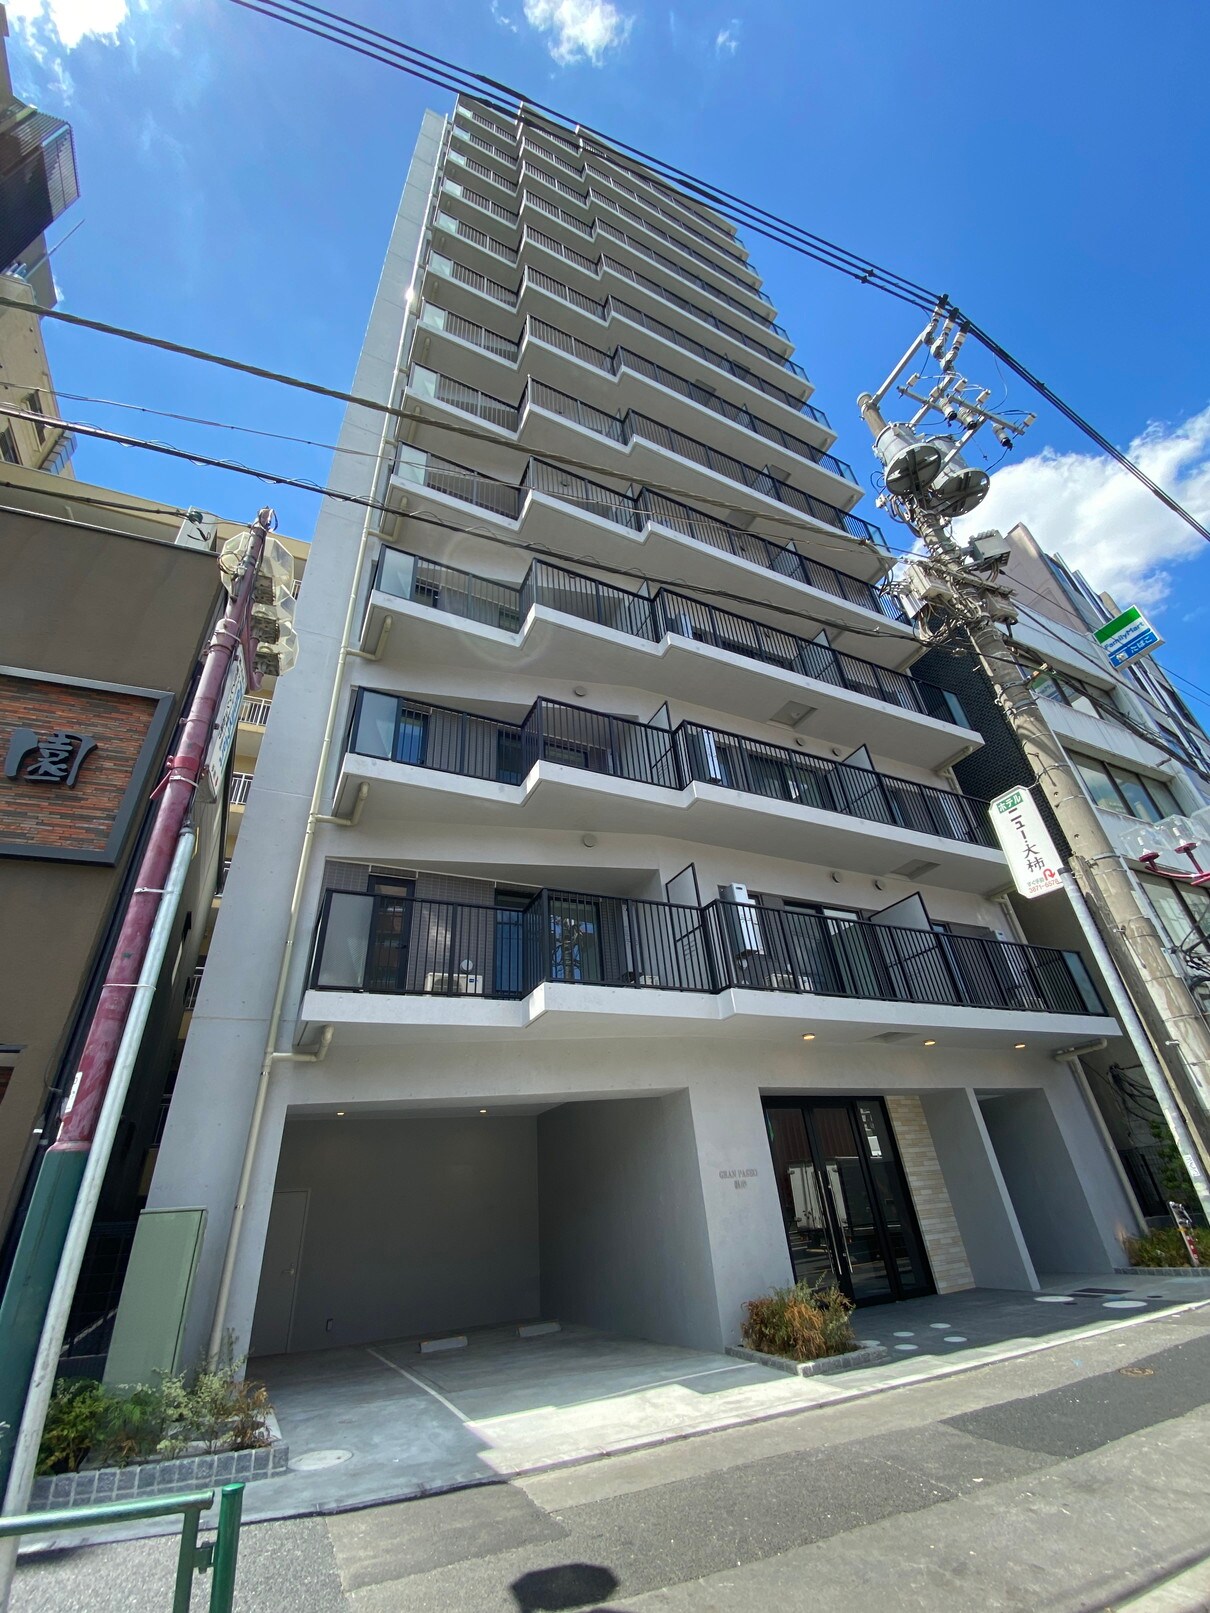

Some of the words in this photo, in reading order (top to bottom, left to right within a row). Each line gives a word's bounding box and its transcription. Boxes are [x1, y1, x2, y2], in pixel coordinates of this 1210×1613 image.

[1104, 622, 1144, 650] FamilyMart
[1130, 636, 1152, 653] たばこ
[4, 727, 97, 786] 園
[998, 794, 1021, 812] ホテル
